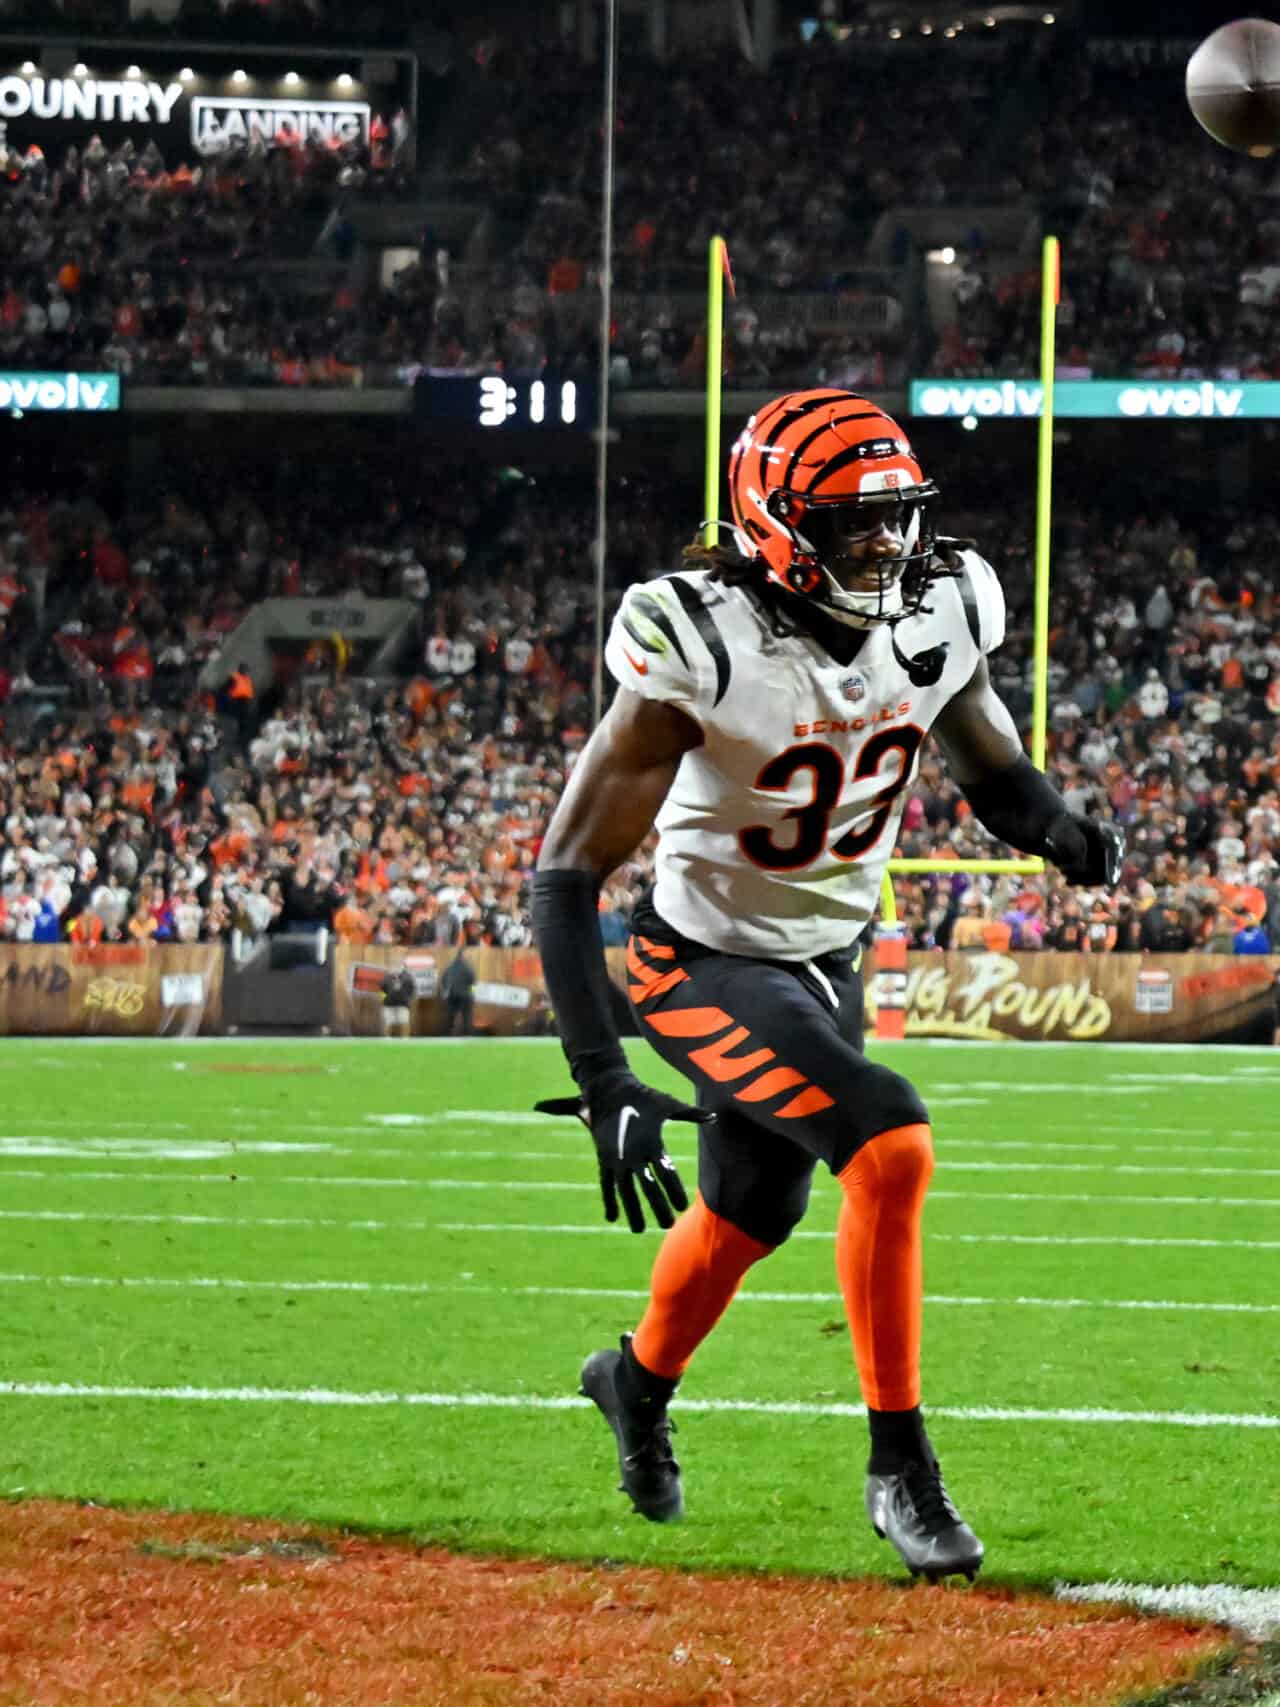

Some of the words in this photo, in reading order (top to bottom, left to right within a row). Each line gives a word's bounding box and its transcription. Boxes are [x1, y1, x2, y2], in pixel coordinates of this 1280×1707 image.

[202, 107, 361, 148] LANDING
[479, 376, 576, 426] 3:11
[920, 380, 1043, 415] evolv
[1117, 381, 1243, 416] evolv
[737, 722, 927, 872] 33
